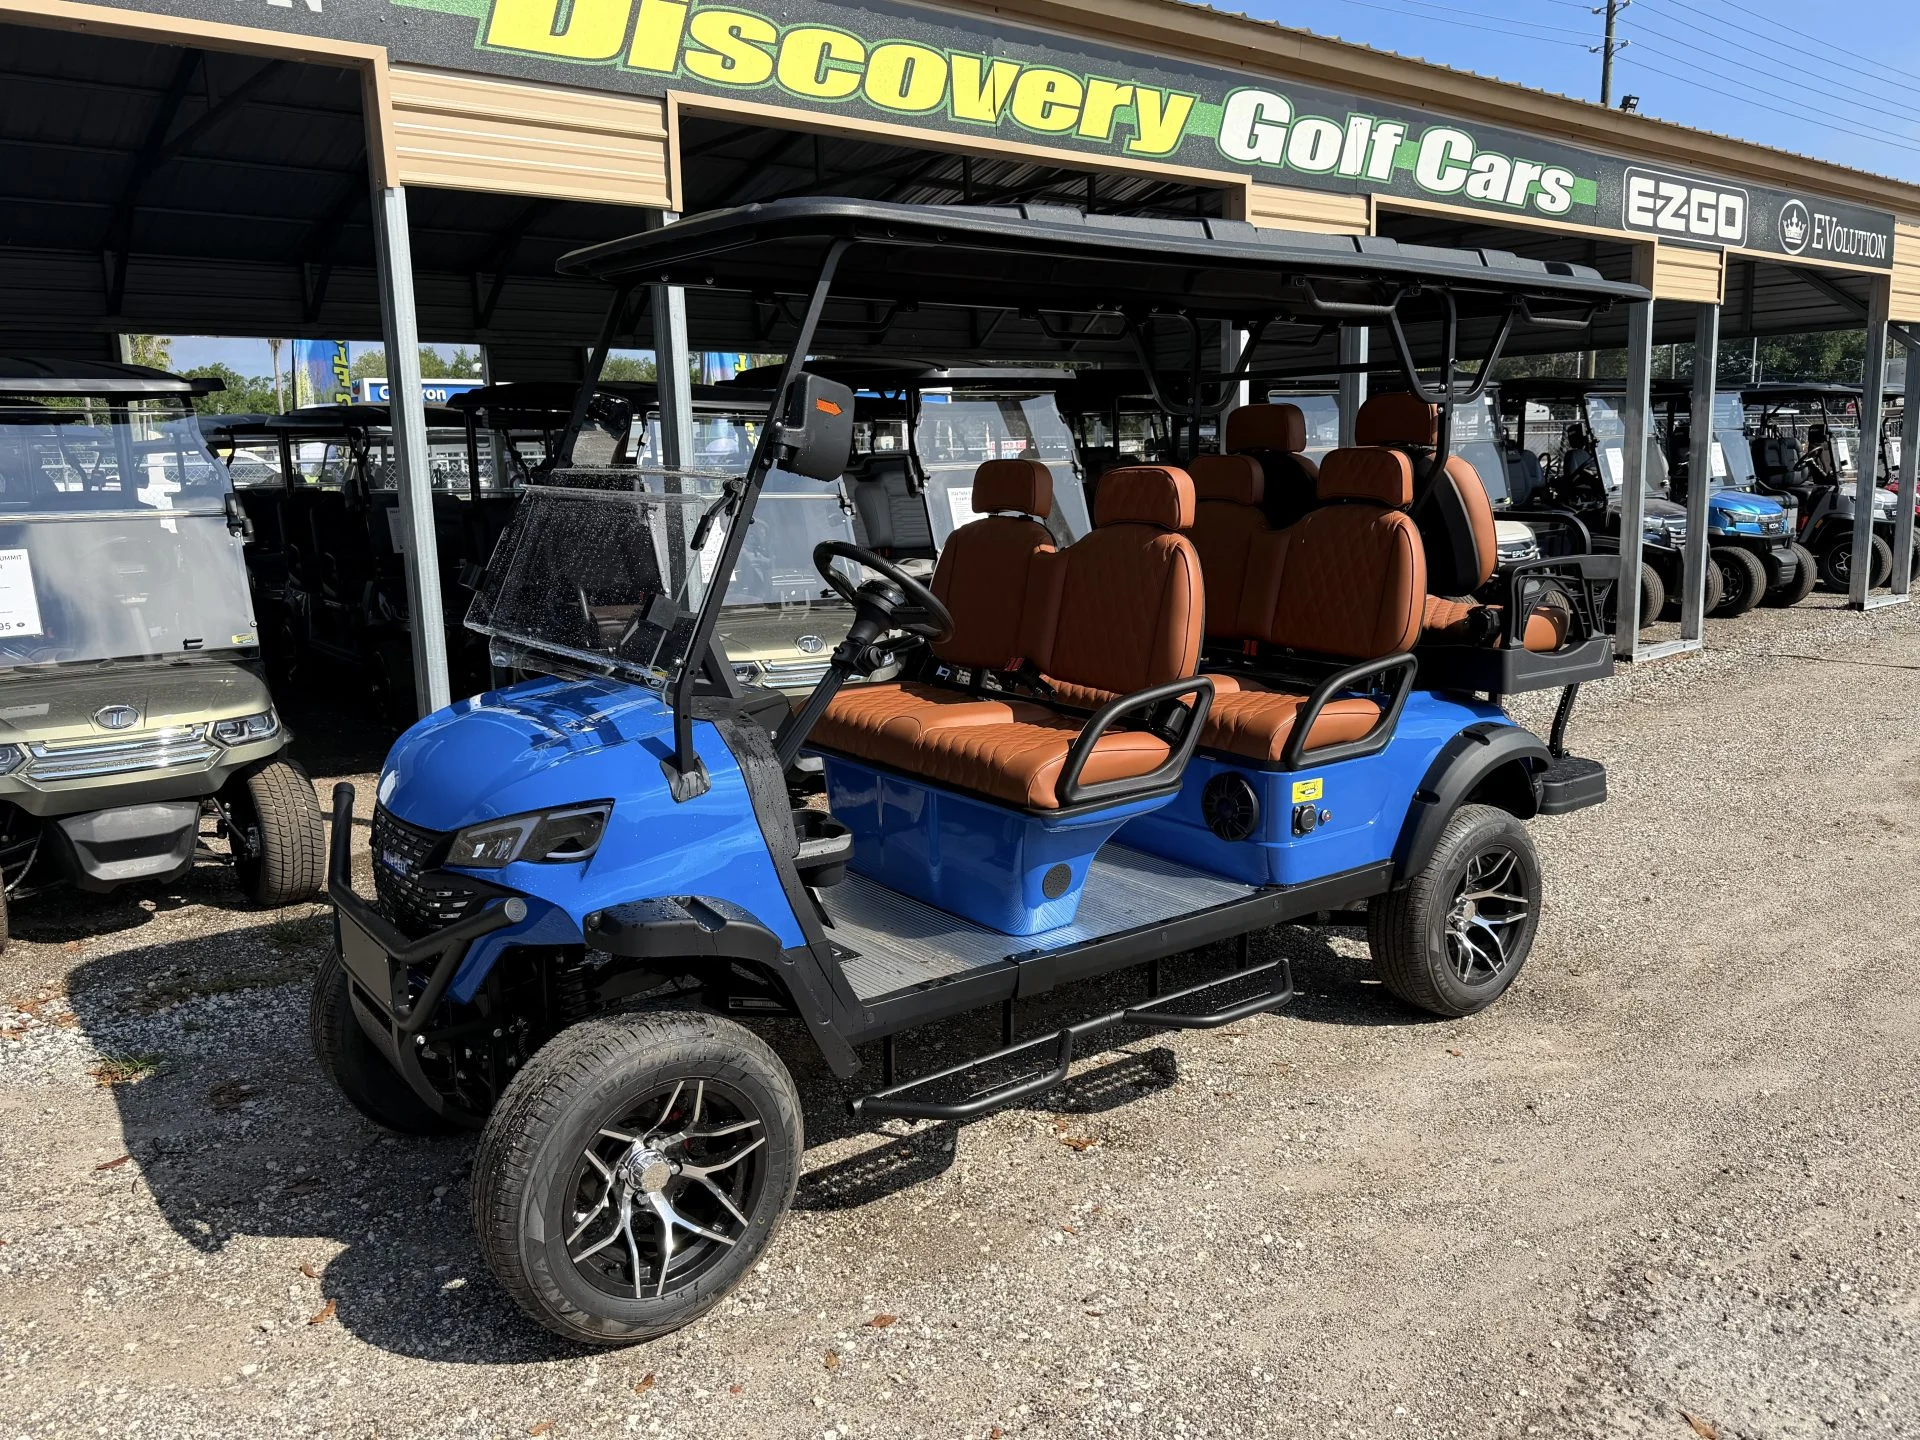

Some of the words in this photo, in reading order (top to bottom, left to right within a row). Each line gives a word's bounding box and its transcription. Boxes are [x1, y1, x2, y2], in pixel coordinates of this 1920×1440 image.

[1221, 88, 1403, 181] Golf
[1417, 126, 1574, 215] Cars
[1512, 550, 1525, 558] EPIC
